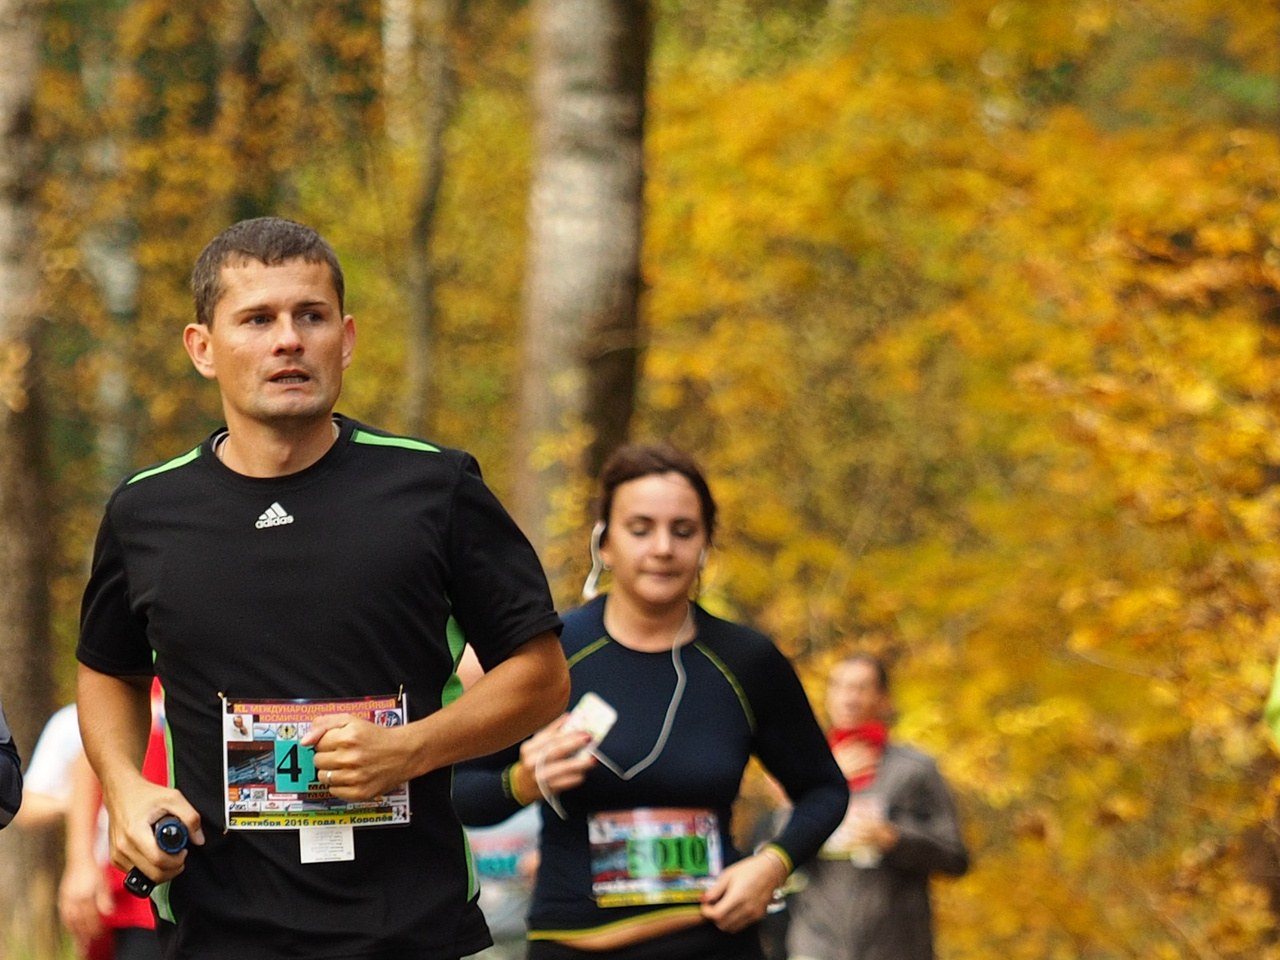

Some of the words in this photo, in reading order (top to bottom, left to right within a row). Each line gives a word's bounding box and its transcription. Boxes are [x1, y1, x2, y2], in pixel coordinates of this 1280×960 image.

[255, 515, 295, 529] adidas
[250, 702, 336, 715] МЕЖДУНАРОДНЫЙ
[284, 818, 310, 827] 2016
[312, 818, 336, 827] года
